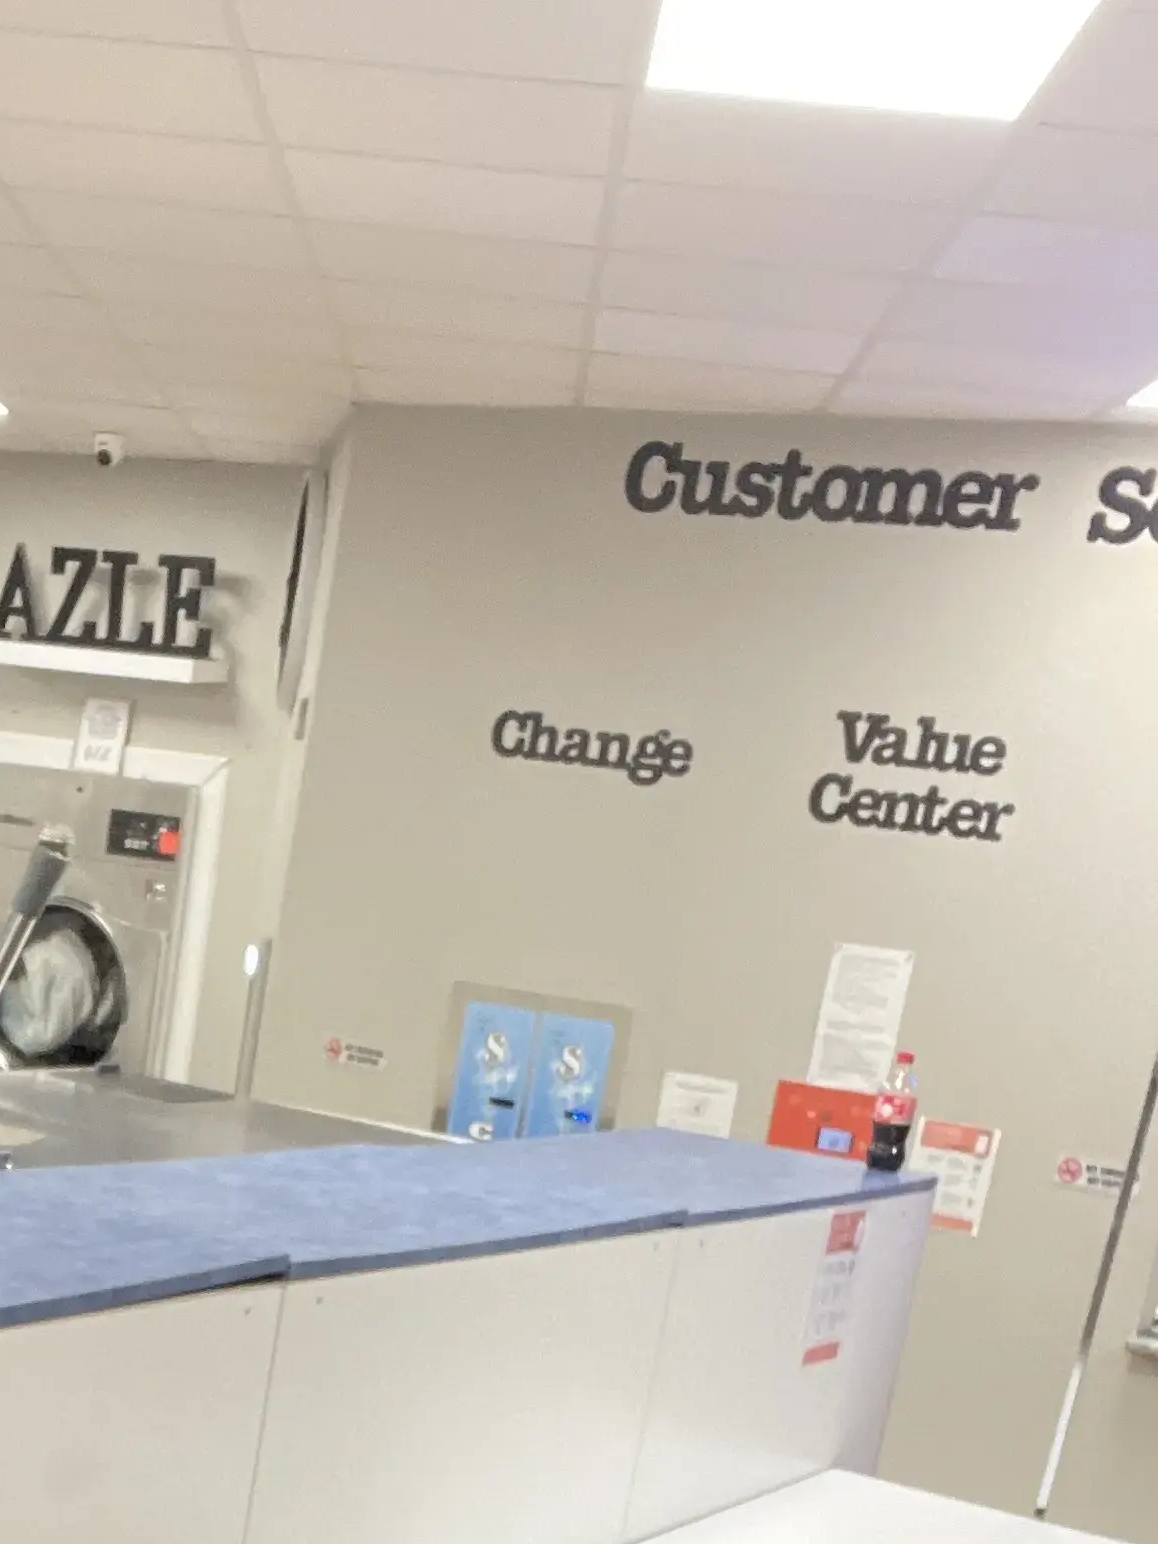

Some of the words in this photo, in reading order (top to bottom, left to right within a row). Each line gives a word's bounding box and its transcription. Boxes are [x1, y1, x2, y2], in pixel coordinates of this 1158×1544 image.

[624, 439, 1040, 531] Customer
[1086, 465, 1158, 544] S
[491, 709, 694, 787] Change
[837, 709, 1008, 776] Value
[807, 772, 1015, 843] Center
